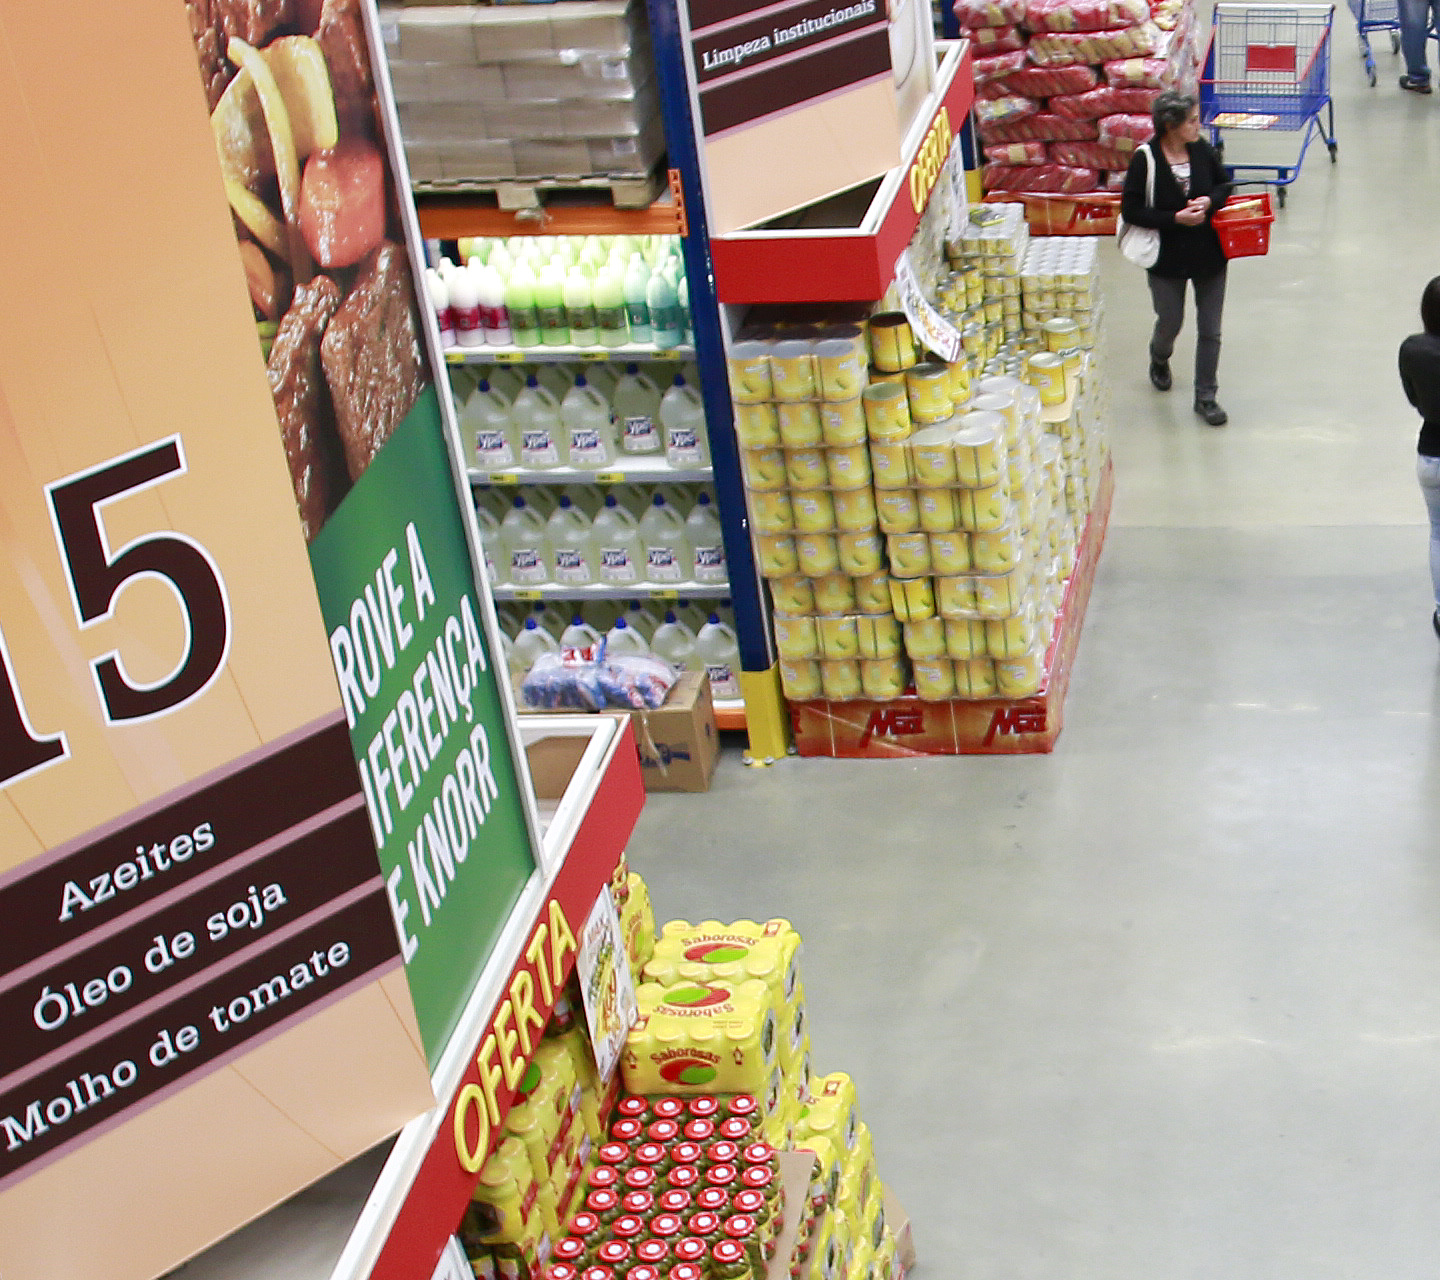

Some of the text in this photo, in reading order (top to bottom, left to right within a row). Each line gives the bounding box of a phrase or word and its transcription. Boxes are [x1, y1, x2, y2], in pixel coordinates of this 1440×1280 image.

[702, 35, 773, 71] Limpeza
[909, 108, 953, 215] OFERTA
[406, 521, 436, 623] A
[58, 817, 217, 921] Azeites
[406, 721, 499, 928] KNORR
[31, 875, 289, 1033] Óleo de soja
[681, 933, 761, 948] Saborosas
[0, 938, 352, 1152] Molho de tomate
[453, 898, 578, 1174] OFERTA
[650, 1045, 722, 1064] Saborosas
[652, 1004, 735, 1018] Saborosas
